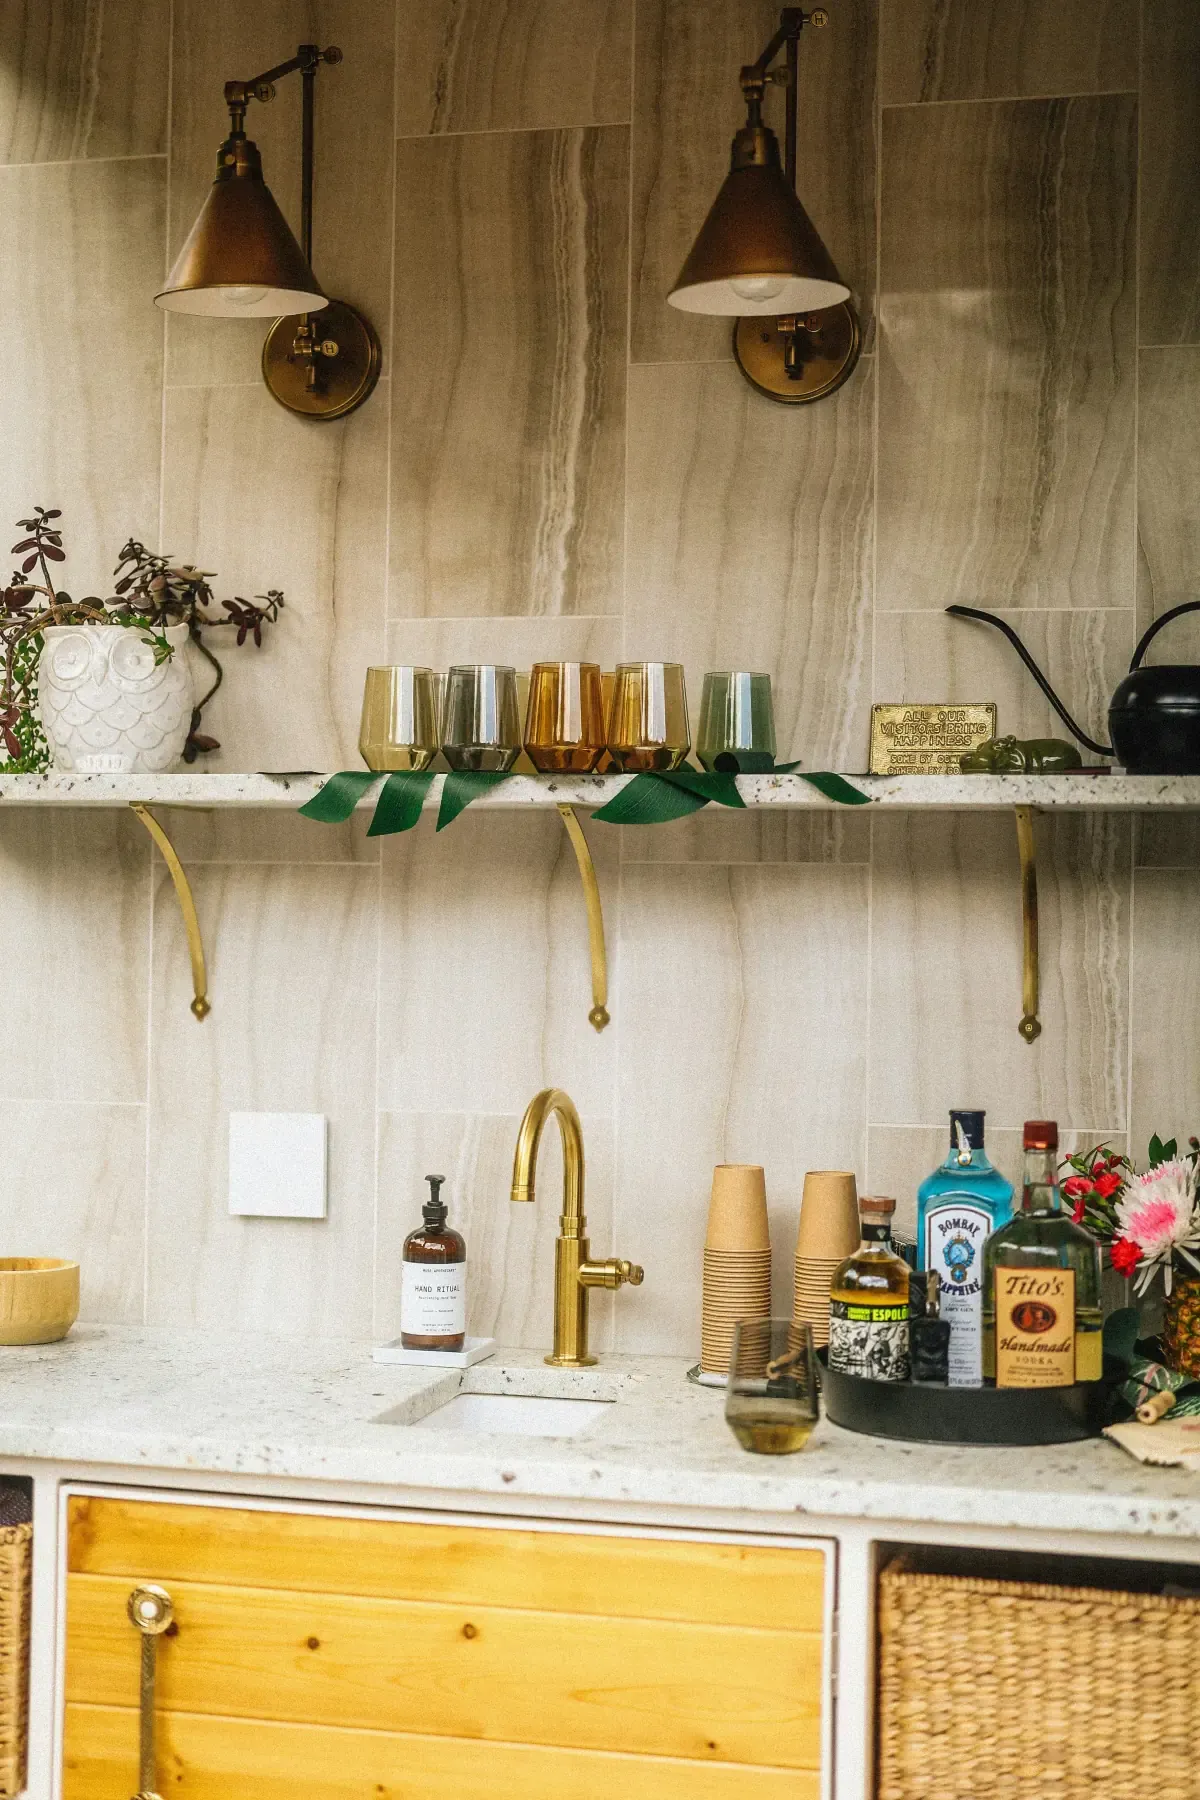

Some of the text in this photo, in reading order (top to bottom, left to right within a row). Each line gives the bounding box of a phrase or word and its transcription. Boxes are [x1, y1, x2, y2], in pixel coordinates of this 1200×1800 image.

[903, 710, 966, 722] ALL OUR
[946, 722, 988, 735] BRING
[893, 735, 972, 746] HAPPINESS
[890, 754, 916, 764] SOME
[919, 754, 934, 764] BY
[927, 766, 942, 775] BY
[938, 1218, 981, 1238] BOMBAY
[414, 1285, 433, 1293] HAND
[1000, 1335, 1072, 1353] Handmade
